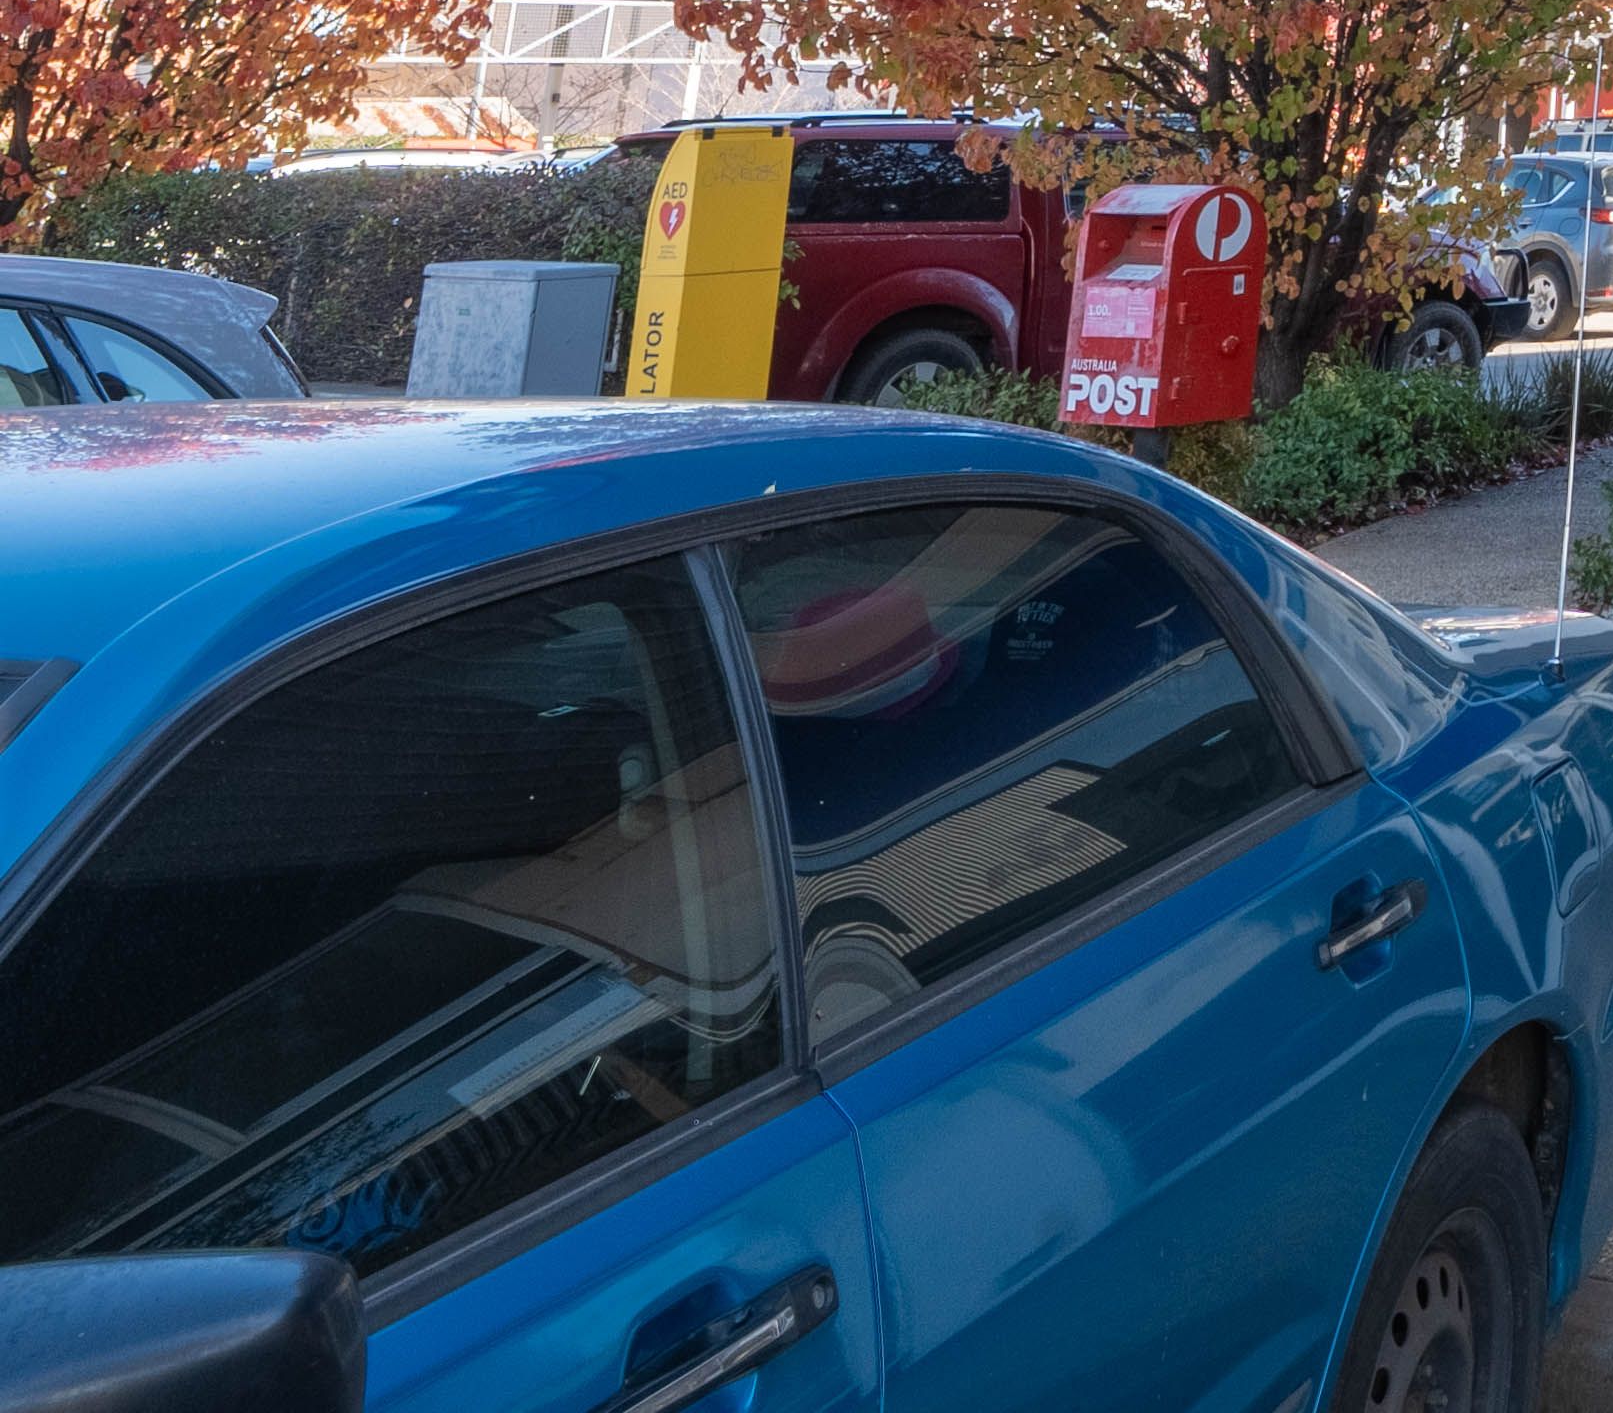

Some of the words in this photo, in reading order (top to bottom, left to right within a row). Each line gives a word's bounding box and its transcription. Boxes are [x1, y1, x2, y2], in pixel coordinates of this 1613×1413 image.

[662, 181, 688, 200] AED
[1071, 358, 1118, 373] AUSTRALIA
[1065, 374, 1159, 417] POST
